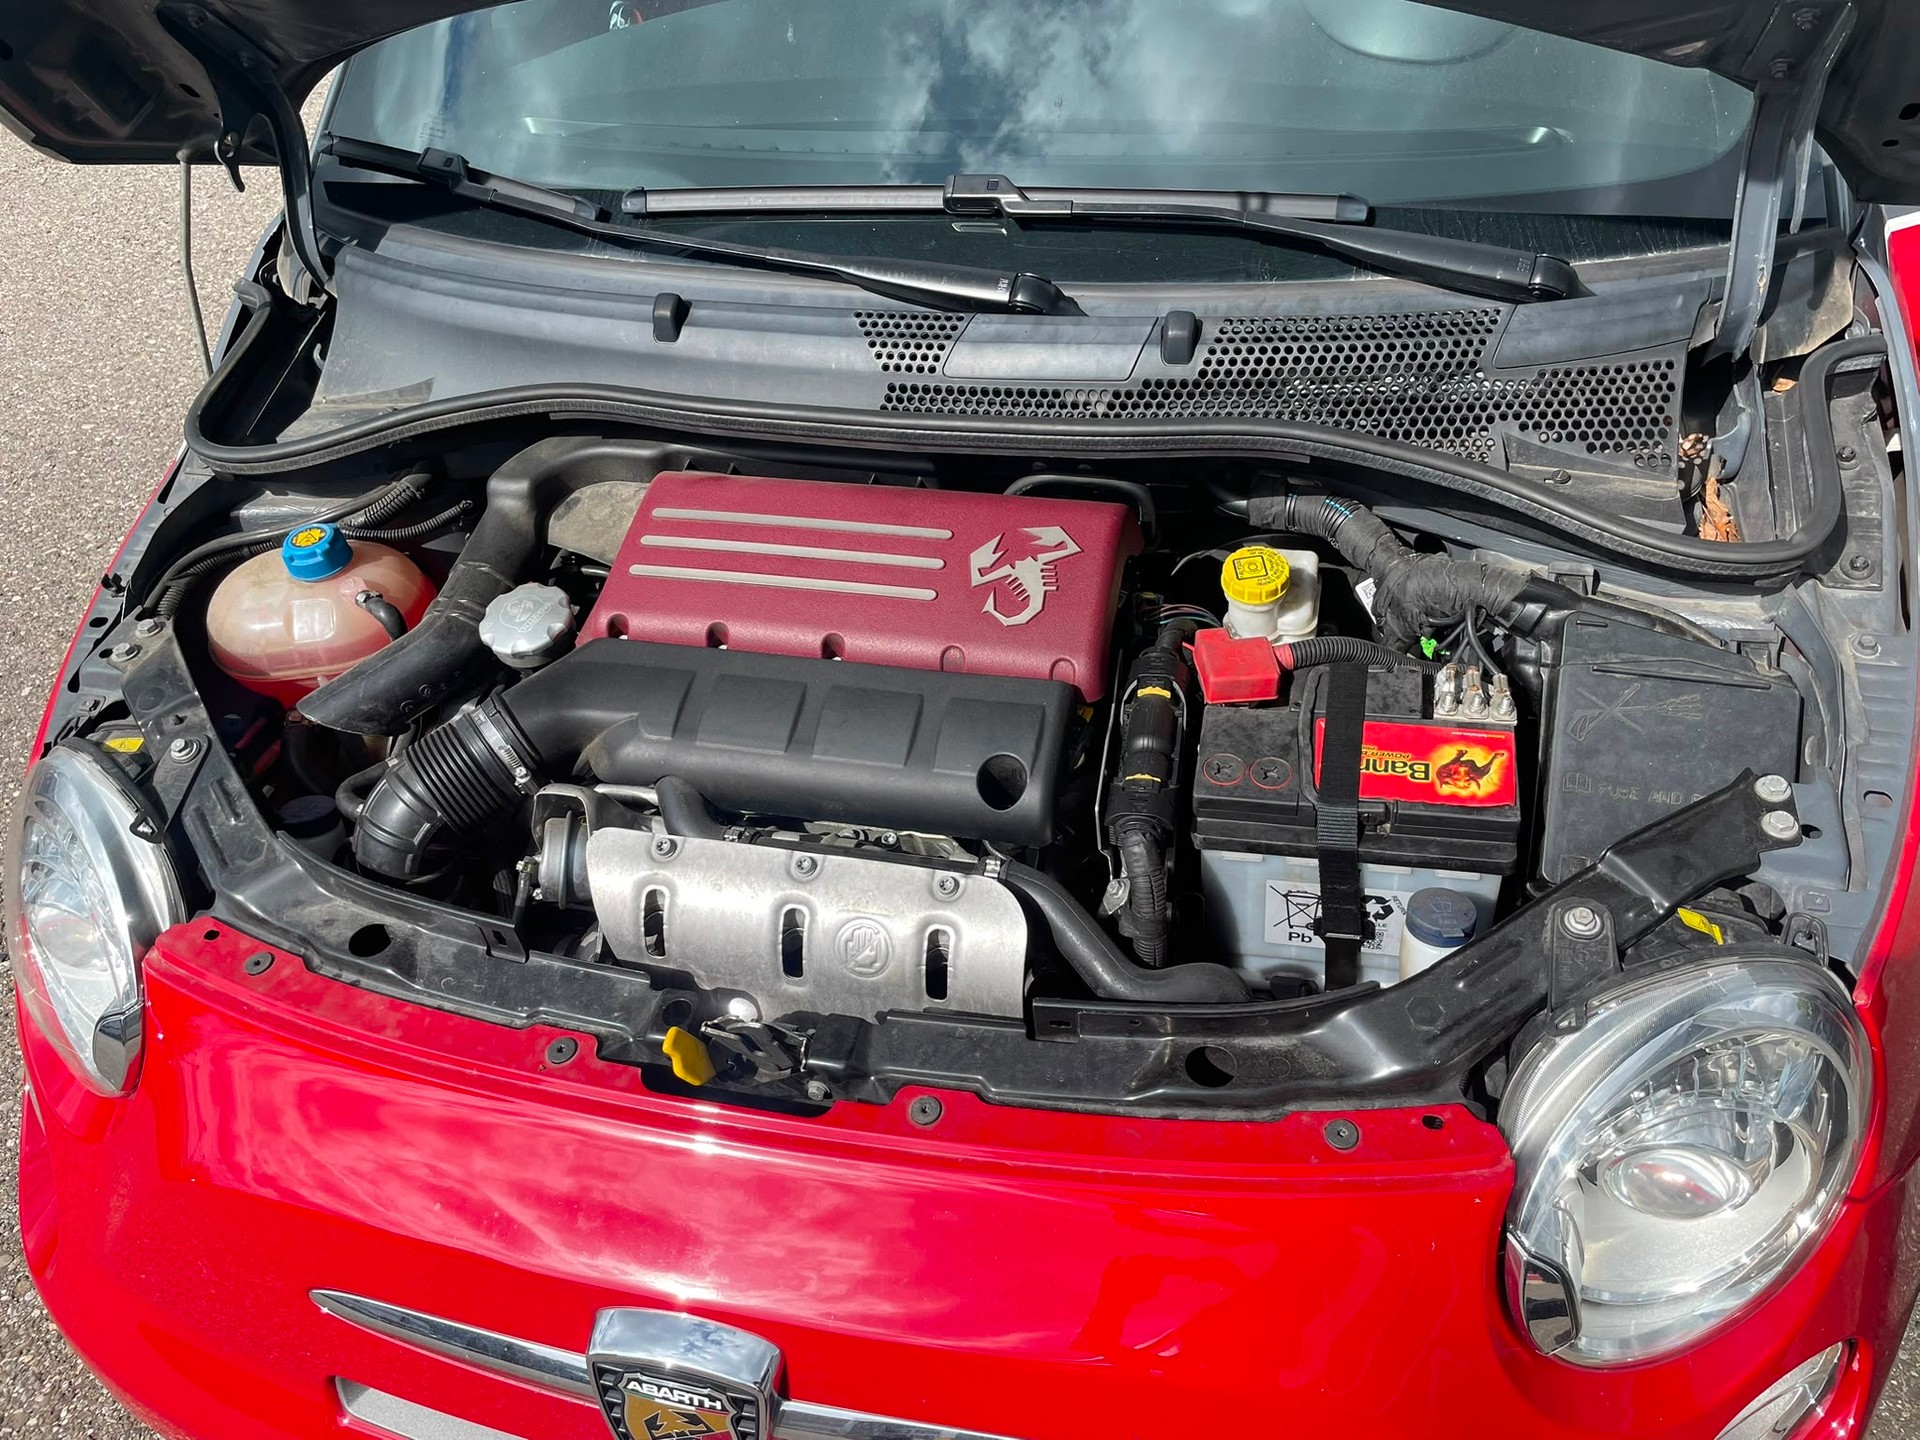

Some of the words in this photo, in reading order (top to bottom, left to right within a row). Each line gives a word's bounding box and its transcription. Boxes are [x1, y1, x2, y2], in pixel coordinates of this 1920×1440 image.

[1371, 751, 1410, 759] POWER
[1598, 783, 1641, 801] FUSE
[1647, 789, 1684, 805] AND
[1288, 931, 1313, 944] Pb
[626, 1380, 723, 1411] ABARTH
